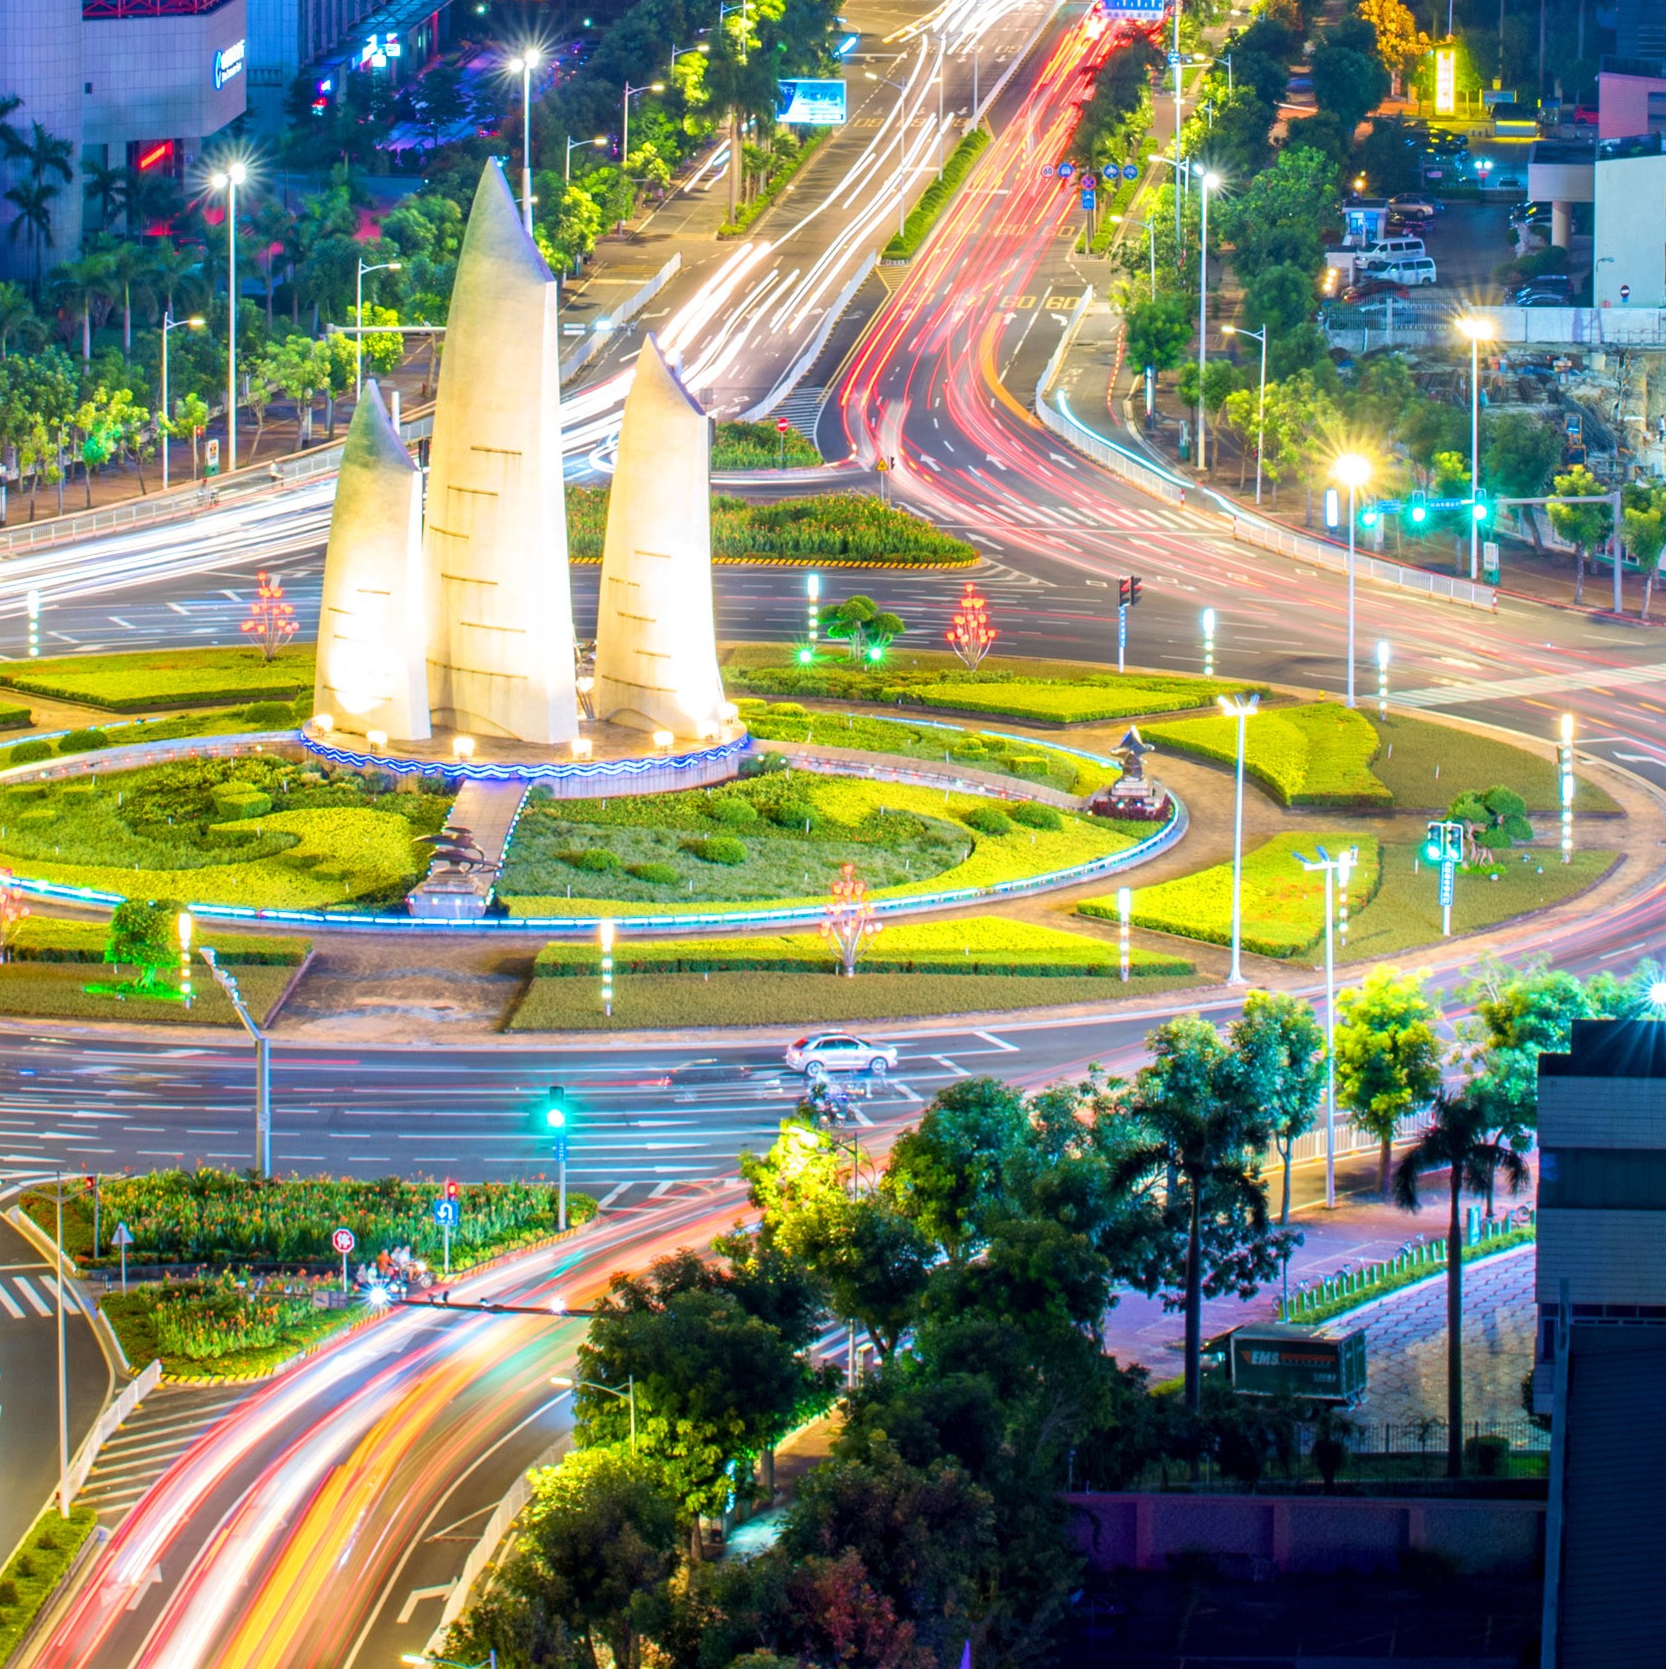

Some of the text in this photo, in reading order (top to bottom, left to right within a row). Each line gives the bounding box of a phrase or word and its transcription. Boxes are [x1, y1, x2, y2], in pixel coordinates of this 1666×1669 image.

[1043, 166, 1053, 176] 60
[1045, 296, 1081, 310] 60
[1251, 1350, 1280, 1366] EMS
